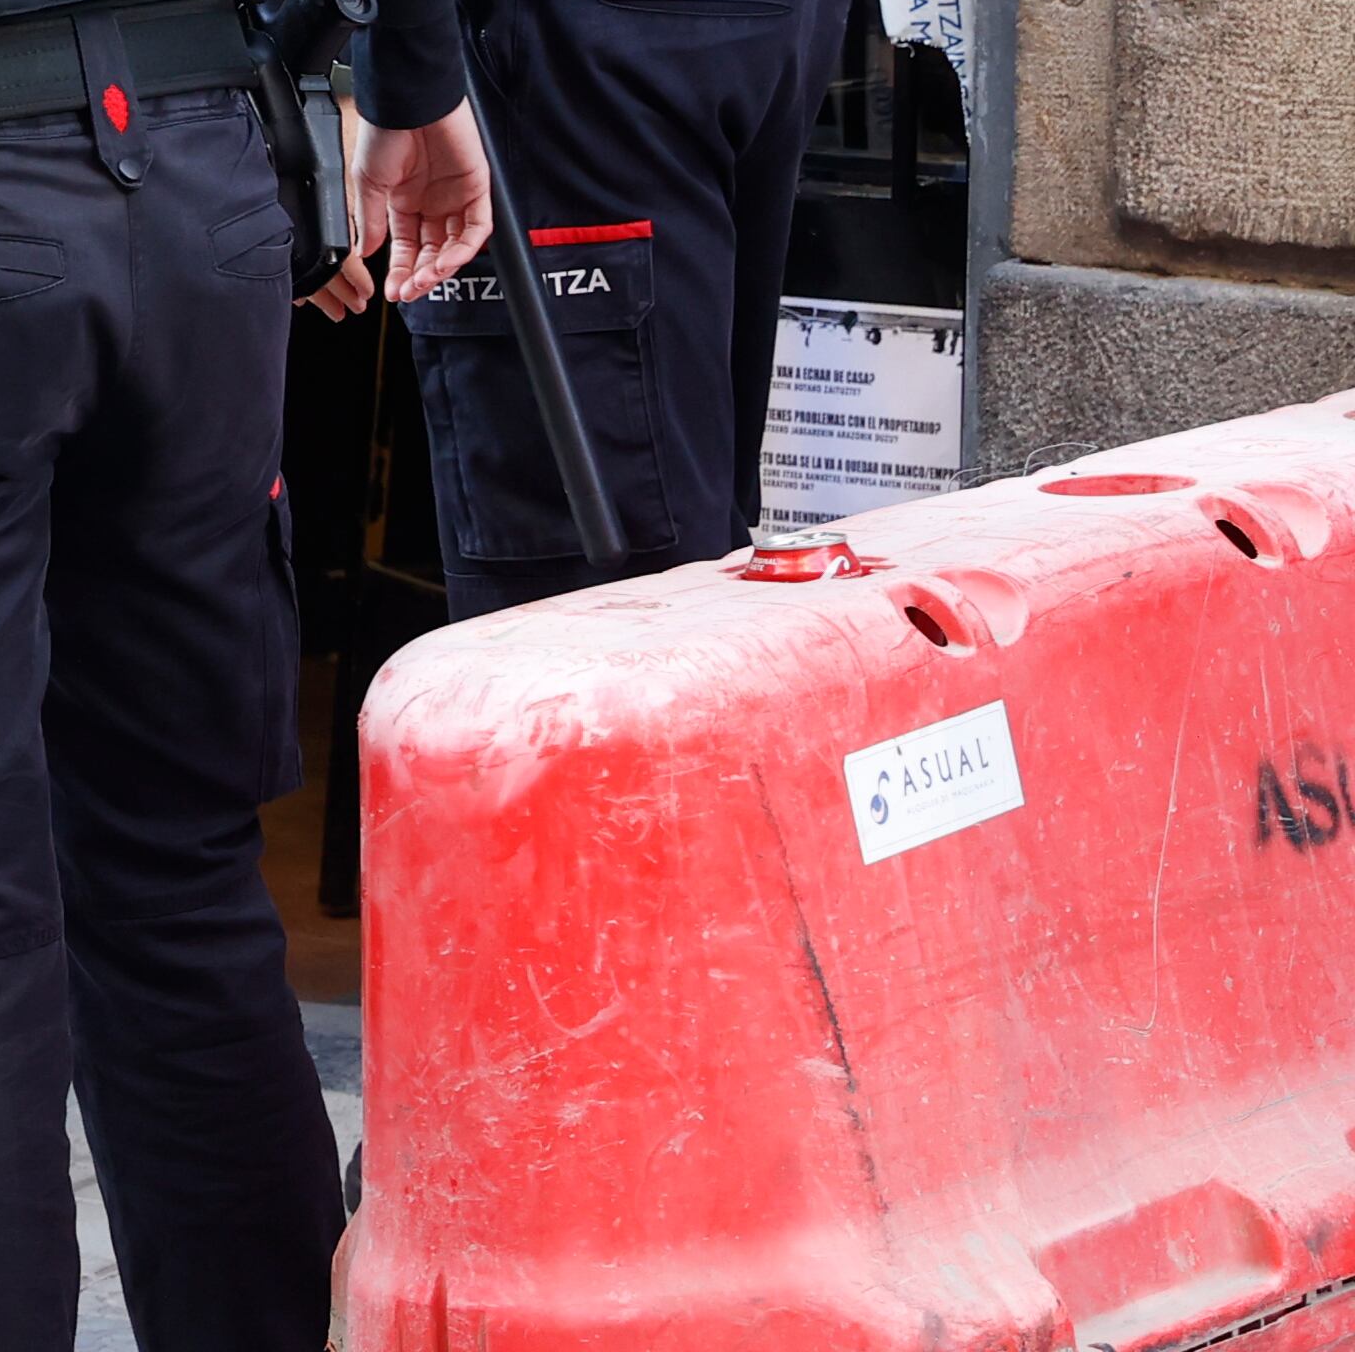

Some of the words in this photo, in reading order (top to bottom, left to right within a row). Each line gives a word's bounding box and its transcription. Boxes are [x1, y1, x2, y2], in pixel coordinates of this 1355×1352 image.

[428, 268, 611, 302] ERTZTZA
[794, 410, 845, 426] PROBLEMAS
[848, 415, 865, 428] CON
[879, 418, 941, 435] PROPIETARIO?
[776, 453, 797, 466] CASA
[800, 455, 809, 468] SE
[812, 456, 821, 469] LA
[824, 458, 835, 470] VA
[902, 738, 989, 796] ASUAL
